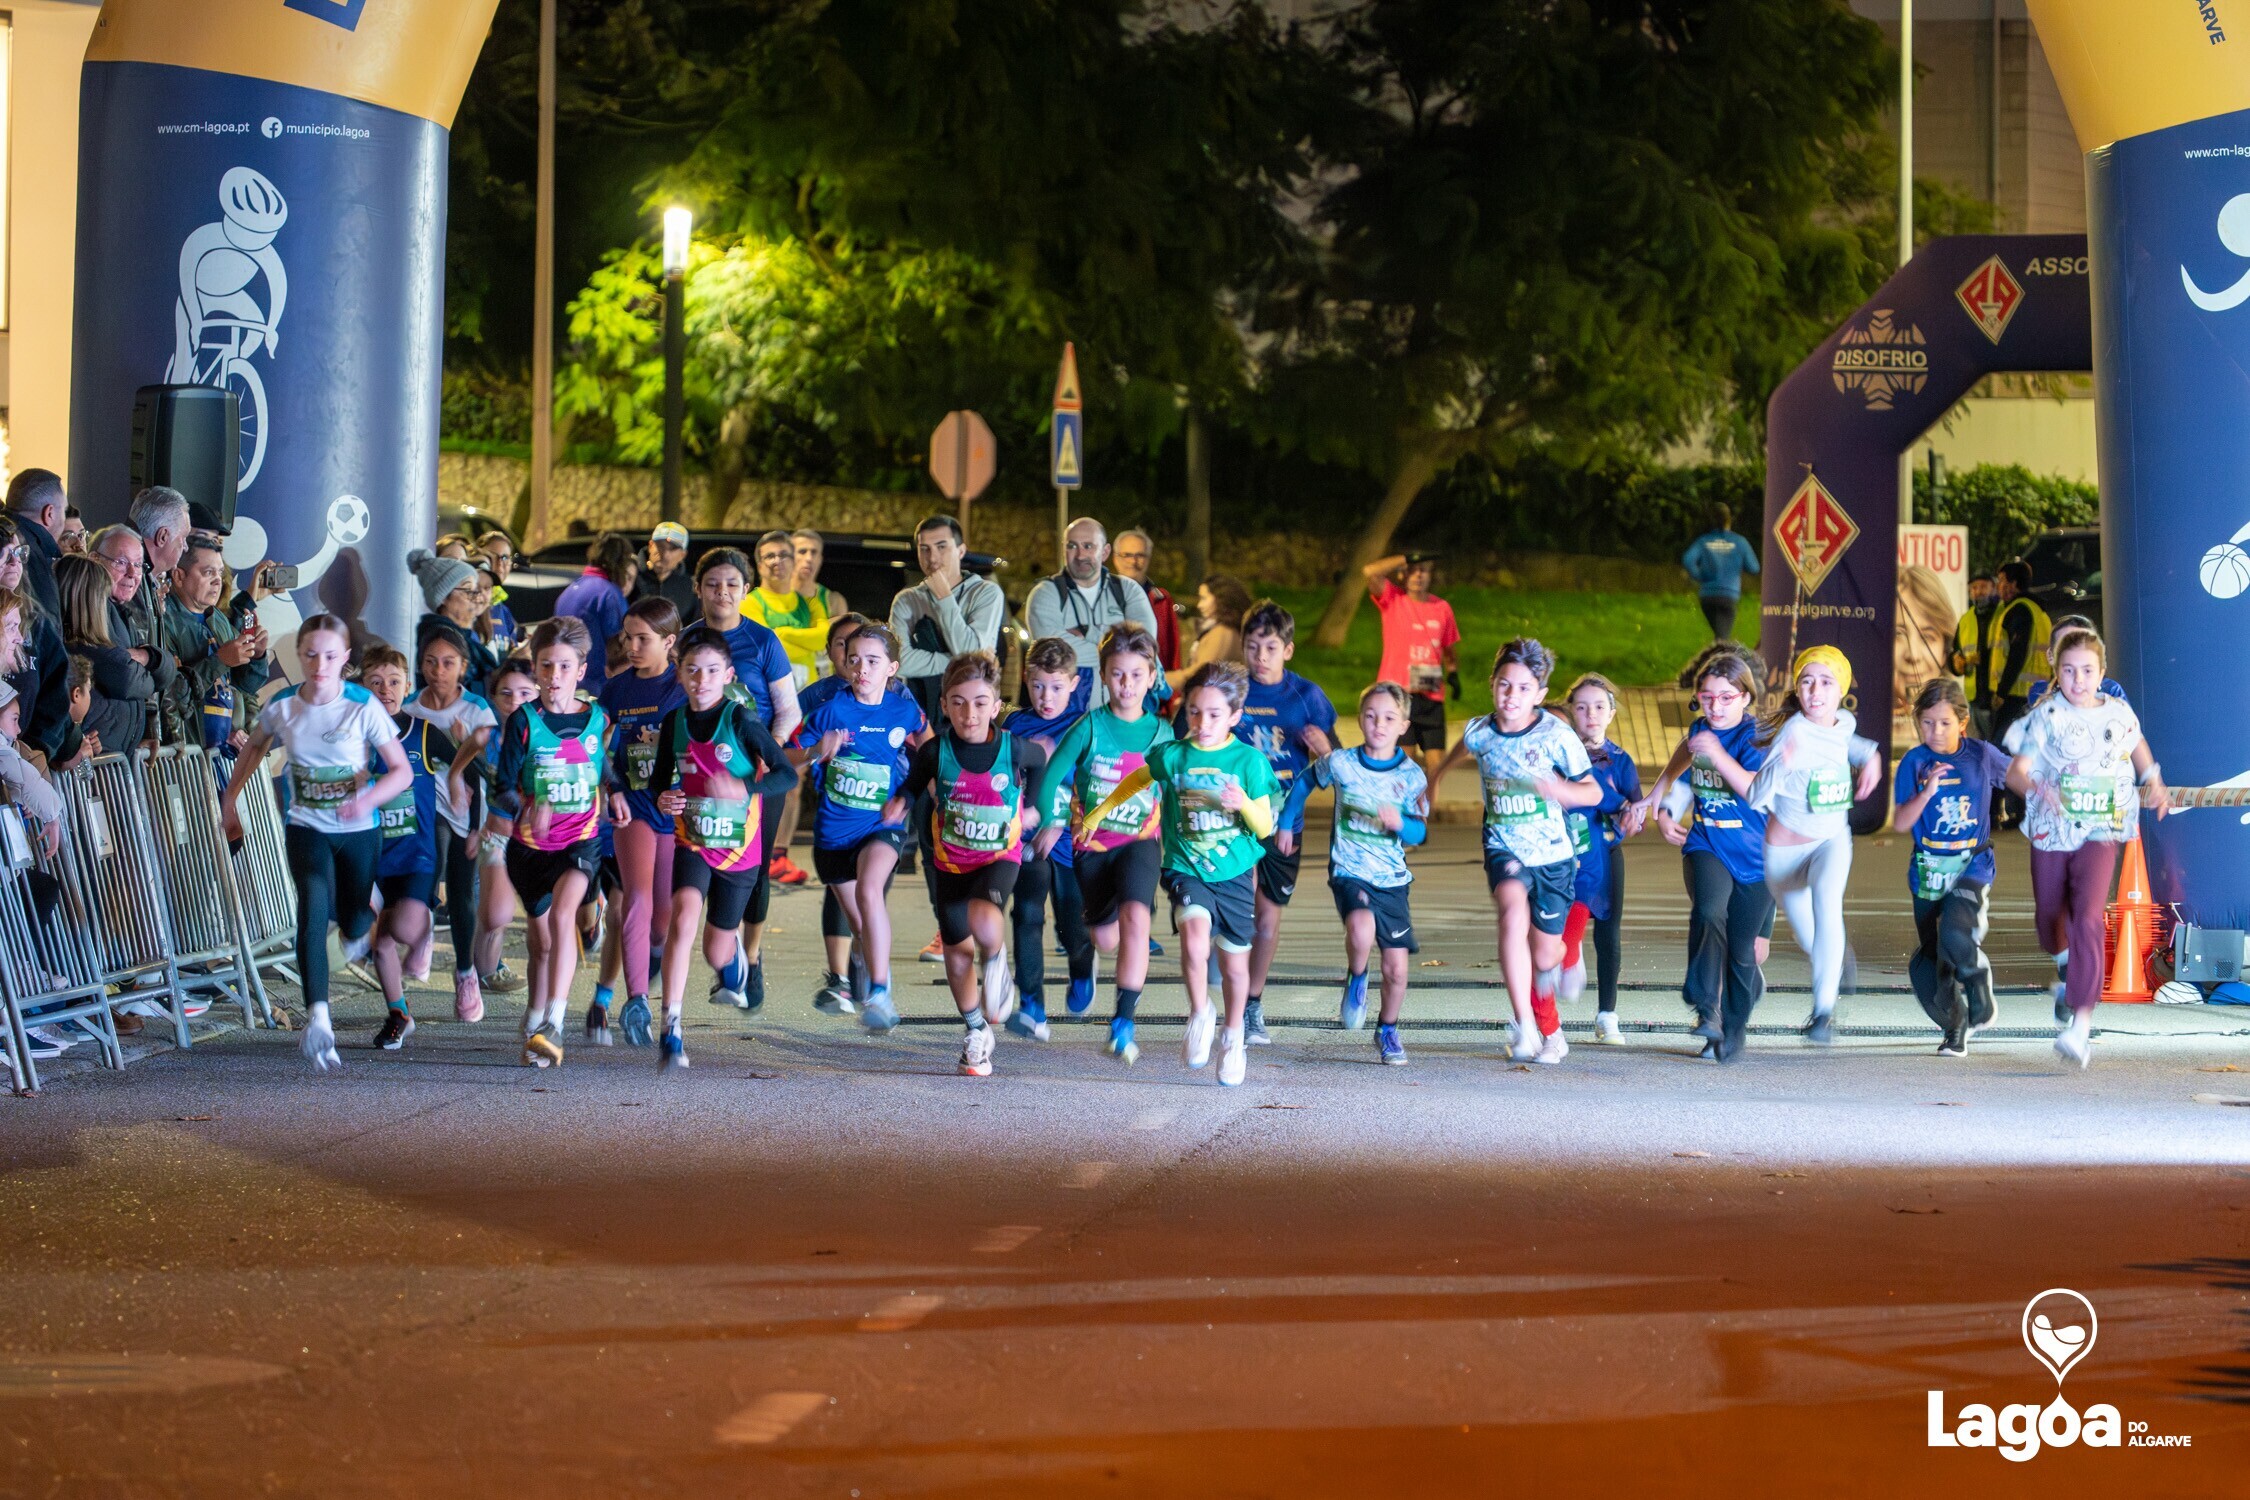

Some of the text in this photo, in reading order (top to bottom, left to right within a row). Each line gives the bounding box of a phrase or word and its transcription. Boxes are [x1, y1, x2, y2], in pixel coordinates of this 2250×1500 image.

[157, 121, 250, 134] www.cm-lagoa.pt
[1833, 349, 1928, 367] DISOFRIO
[547, 778, 590, 802] 3014
[834, 773, 879, 799] 3002
[1492, 793, 1537, 815] 3006
[2071, 791, 2109, 812] 3012
[692, 815, 733, 837] 3015
[954, 817, 1000, 840] 3020
